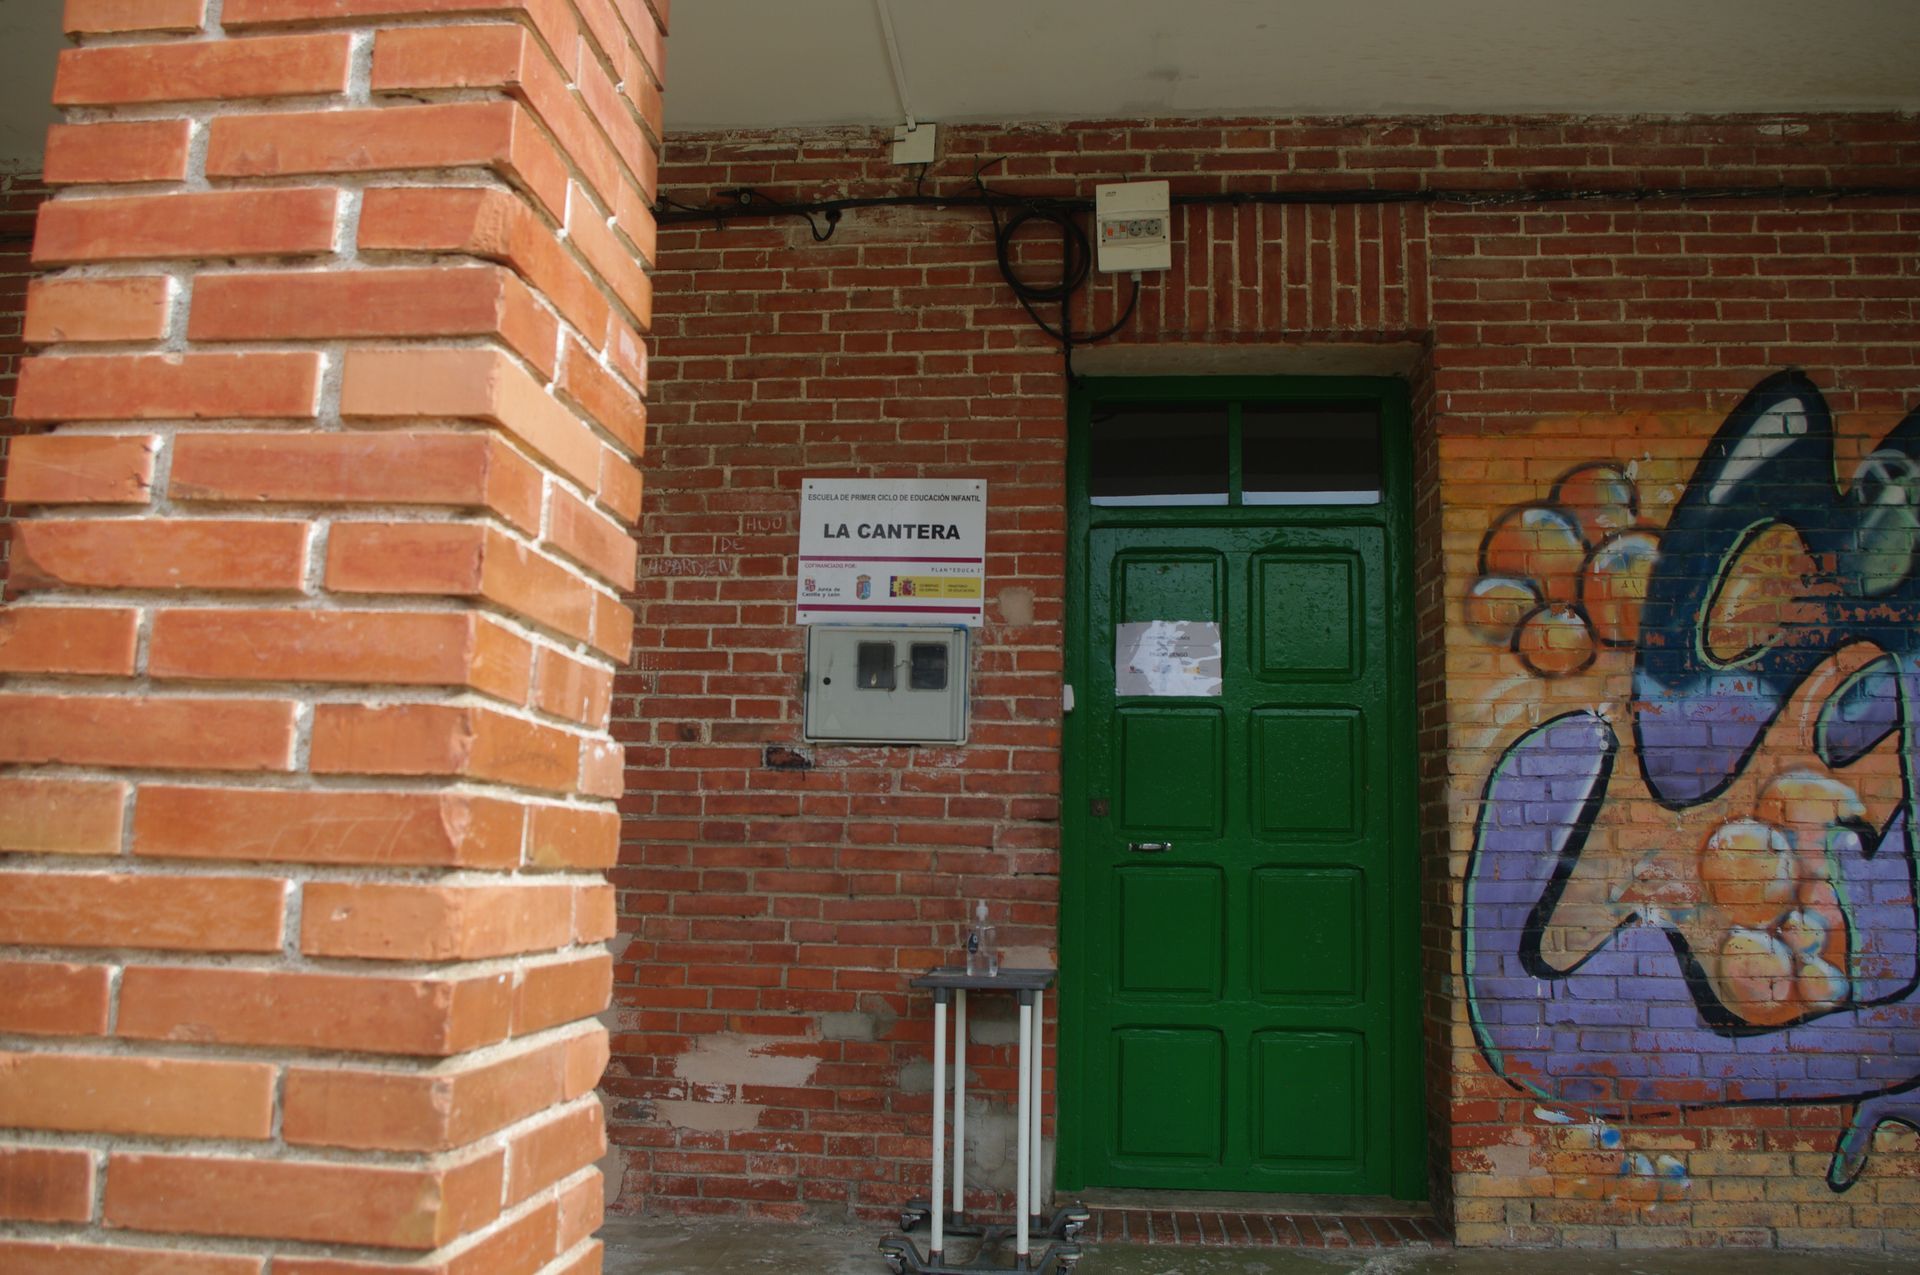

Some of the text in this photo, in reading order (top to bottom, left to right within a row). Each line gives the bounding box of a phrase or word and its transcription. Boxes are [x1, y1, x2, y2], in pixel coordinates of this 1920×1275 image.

[808, 493, 839, 501] ESCUELA
[840, 493, 849, 501] DE
[900, 494, 909, 502] DE
[910, 493, 950, 502] EDUCACIÓN
[823, 523, 961, 540] LA CANTERA
